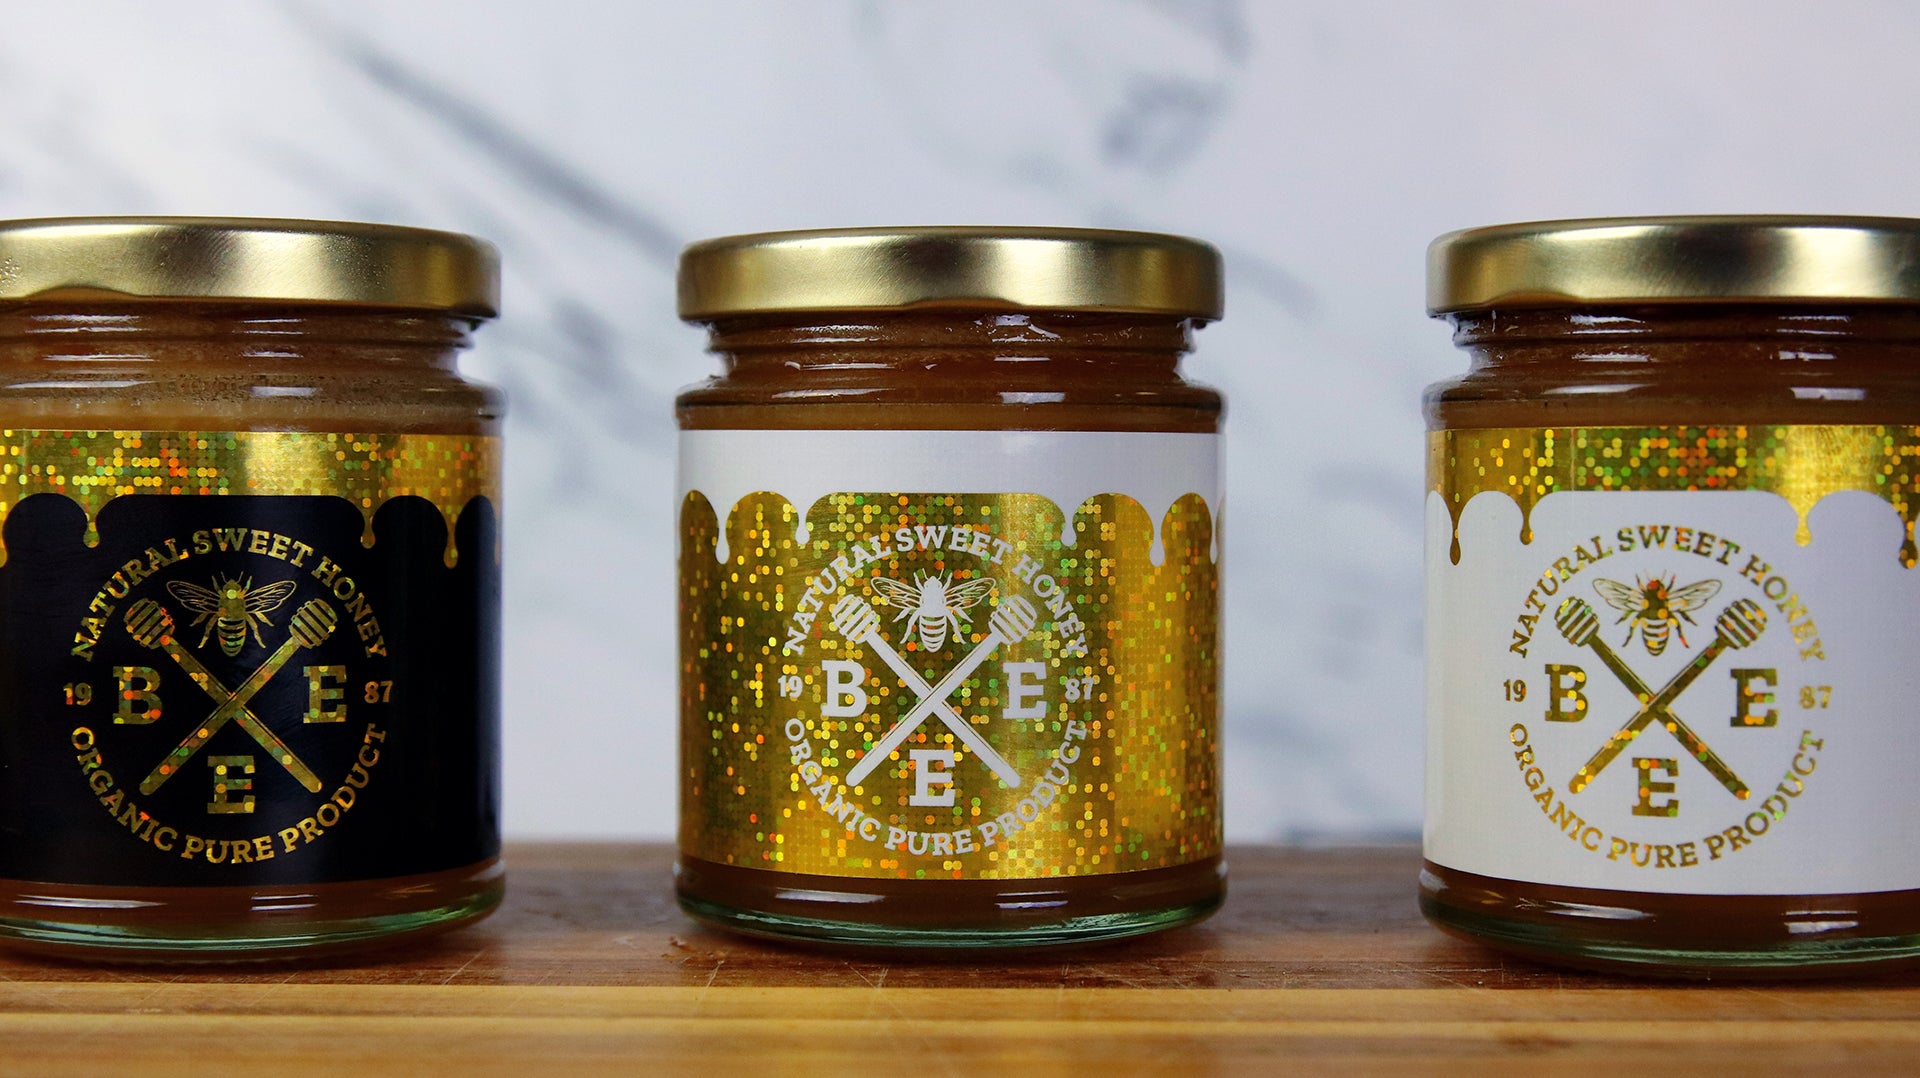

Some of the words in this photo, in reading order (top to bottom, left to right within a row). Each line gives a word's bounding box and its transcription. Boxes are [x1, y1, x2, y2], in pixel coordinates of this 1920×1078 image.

[71, 538, 189, 662] NATURAL
[193, 528, 314, 568] SWEET
[311, 556, 387, 658] HONEY
[784, 535, 892, 655] NATURAL
[895, 525, 1014, 565] SWEET
[1012, 554, 1089, 656] HONEY
[1509, 535, 1613, 658] NATURAL
[1617, 525, 1740, 566] SWEET
[1739, 554, 1826, 661] HONEY
[63, 683, 92, 705] 19
[364, 680, 394, 703] 87
[112, 665, 163, 725] B
[303, 665, 347, 723] E
[777, 676, 803, 697] 19
[1065, 678, 1095, 700] 87
[821, 660, 867, 718] B
[1002, 662, 1047, 719] E
[1503, 679, 1527, 702] 19
[1798, 685, 1832, 709] 87
[1544, 664, 1589, 722] B
[1730, 668, 1778, 727] E
[71, 726, 178, 851] ORGANIC
[181, 834, 275, 864] PURE
[278, 723, 386, 853] PRODUCT
[207, 755, 255, 814] E
[785, 718, 881, 842] ORGANIC
[884, 826, 973, 856] PURE
[977, 720, 1088, 846] PRODUCT
[909, 749, 956, 807] E
[1509, 723, 1603, 851] ORGANIC
[1606, 836, 1698, 868] PURE
[1703, 730, 1824, 860] PRODUCT
[1631, 757, 1679, 818] E
